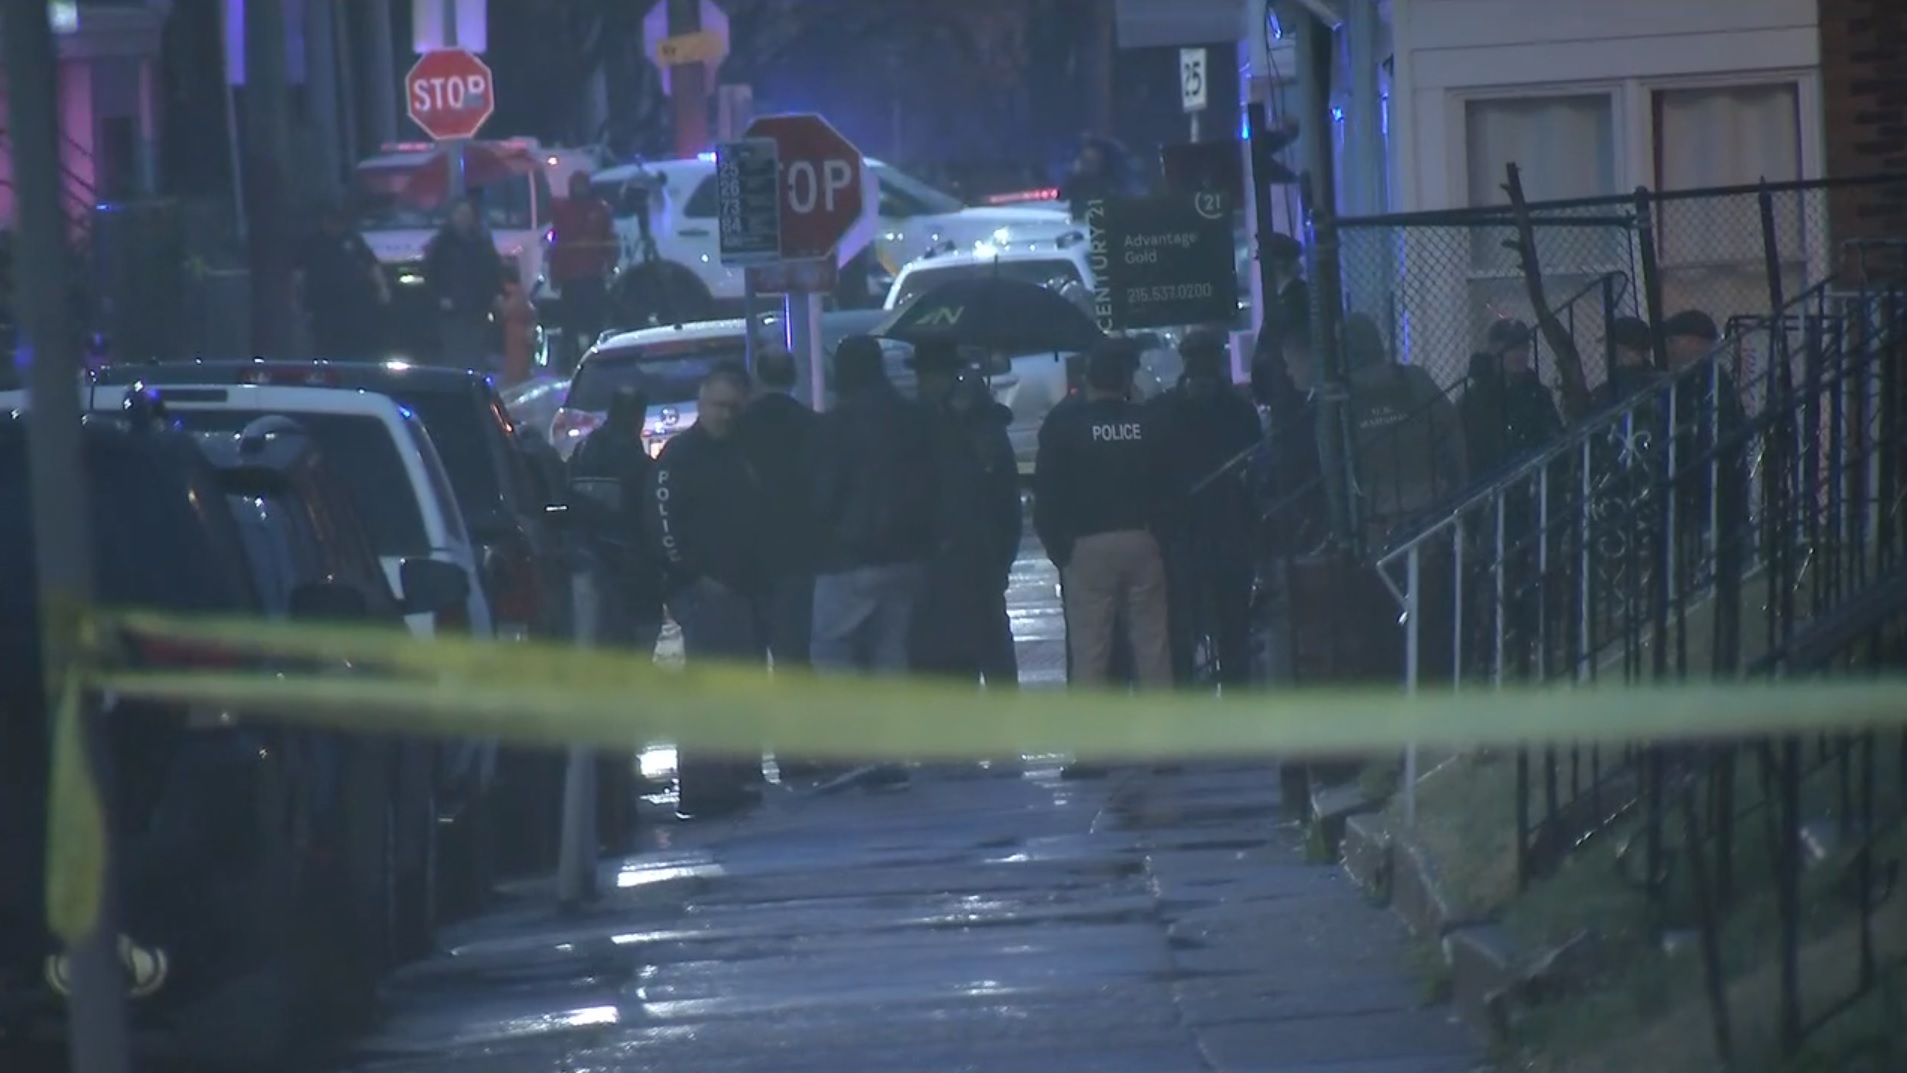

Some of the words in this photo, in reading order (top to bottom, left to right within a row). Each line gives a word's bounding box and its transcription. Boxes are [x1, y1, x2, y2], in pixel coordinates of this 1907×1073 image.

[1184, 61, 1202, 97] 25
[413, 76, 485, 111] STOP
[721, 180, 740, 197] 26
[779, 160, 852, 214] OP
[1087, 199, 1105, 217] 21
[1124, 232, 1197, 248] Advantage
[1124, 251, 1158, 264] Gold
[1089, 226, 1112, 334] CENTURY
[1092, 423, 1142, 441] POLICE
[656, 470, 681, 562] POLICE
